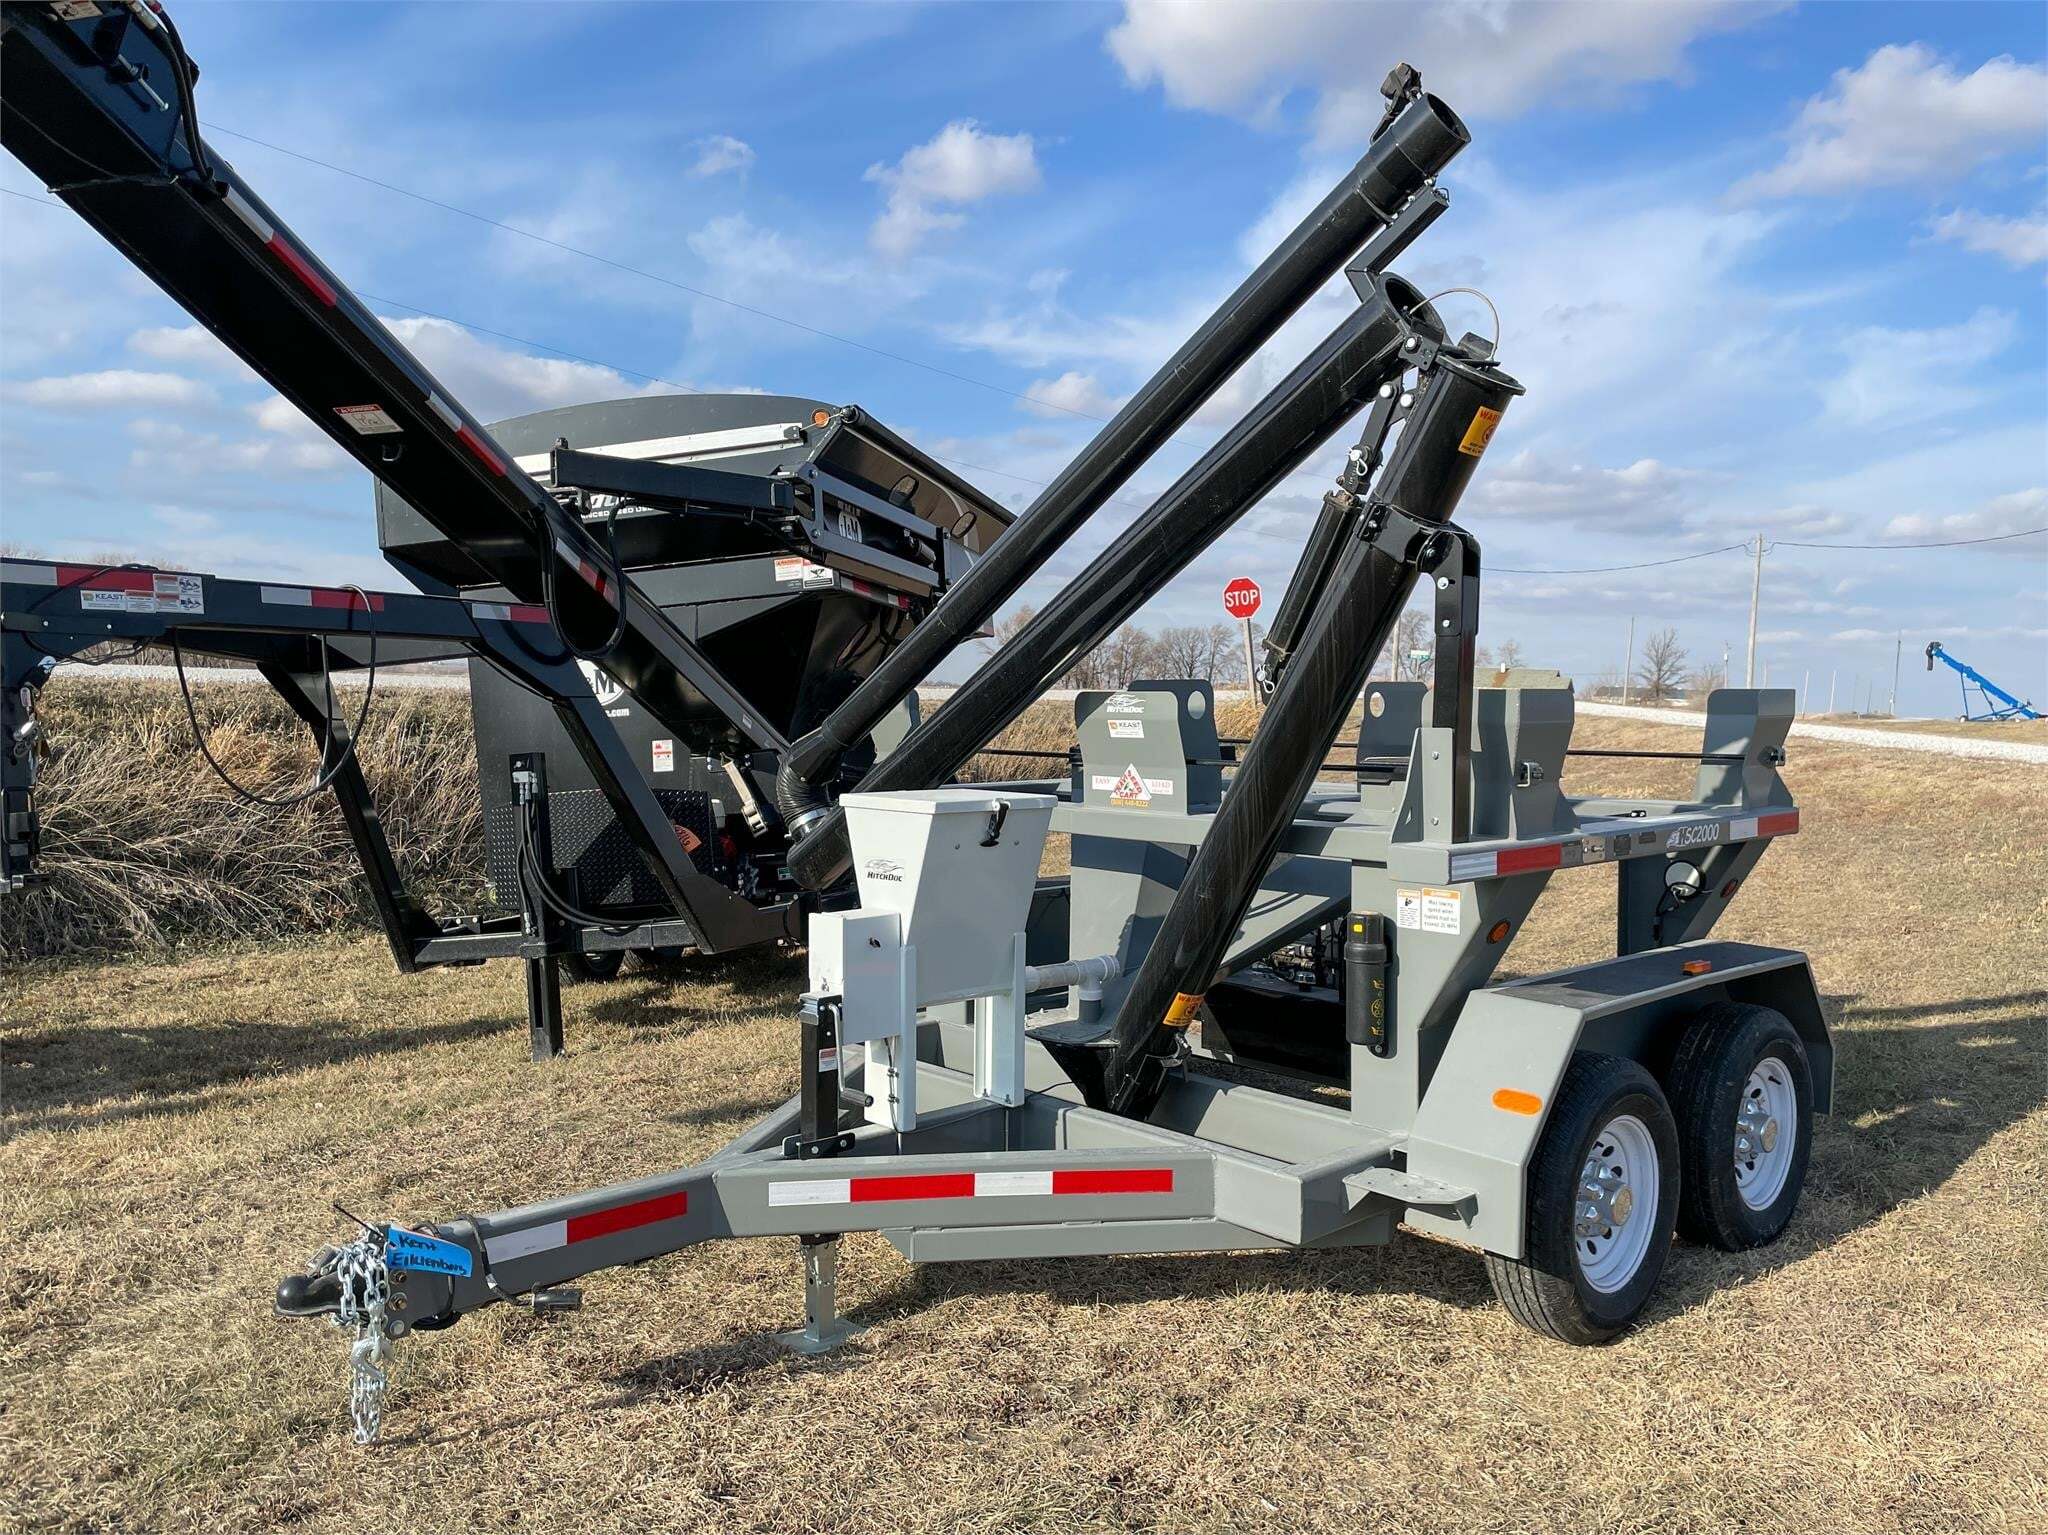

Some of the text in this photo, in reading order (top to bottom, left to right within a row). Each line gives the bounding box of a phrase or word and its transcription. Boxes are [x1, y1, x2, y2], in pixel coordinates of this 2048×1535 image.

[95, 593, 124, 601] KEAST
[1225, 588, 1258, 608] STOP
[1119, 791, 1138, 800] CART
[1680, 823, 1720, 845] TSC2000
[399, 1234, 437, 1251] Kent
